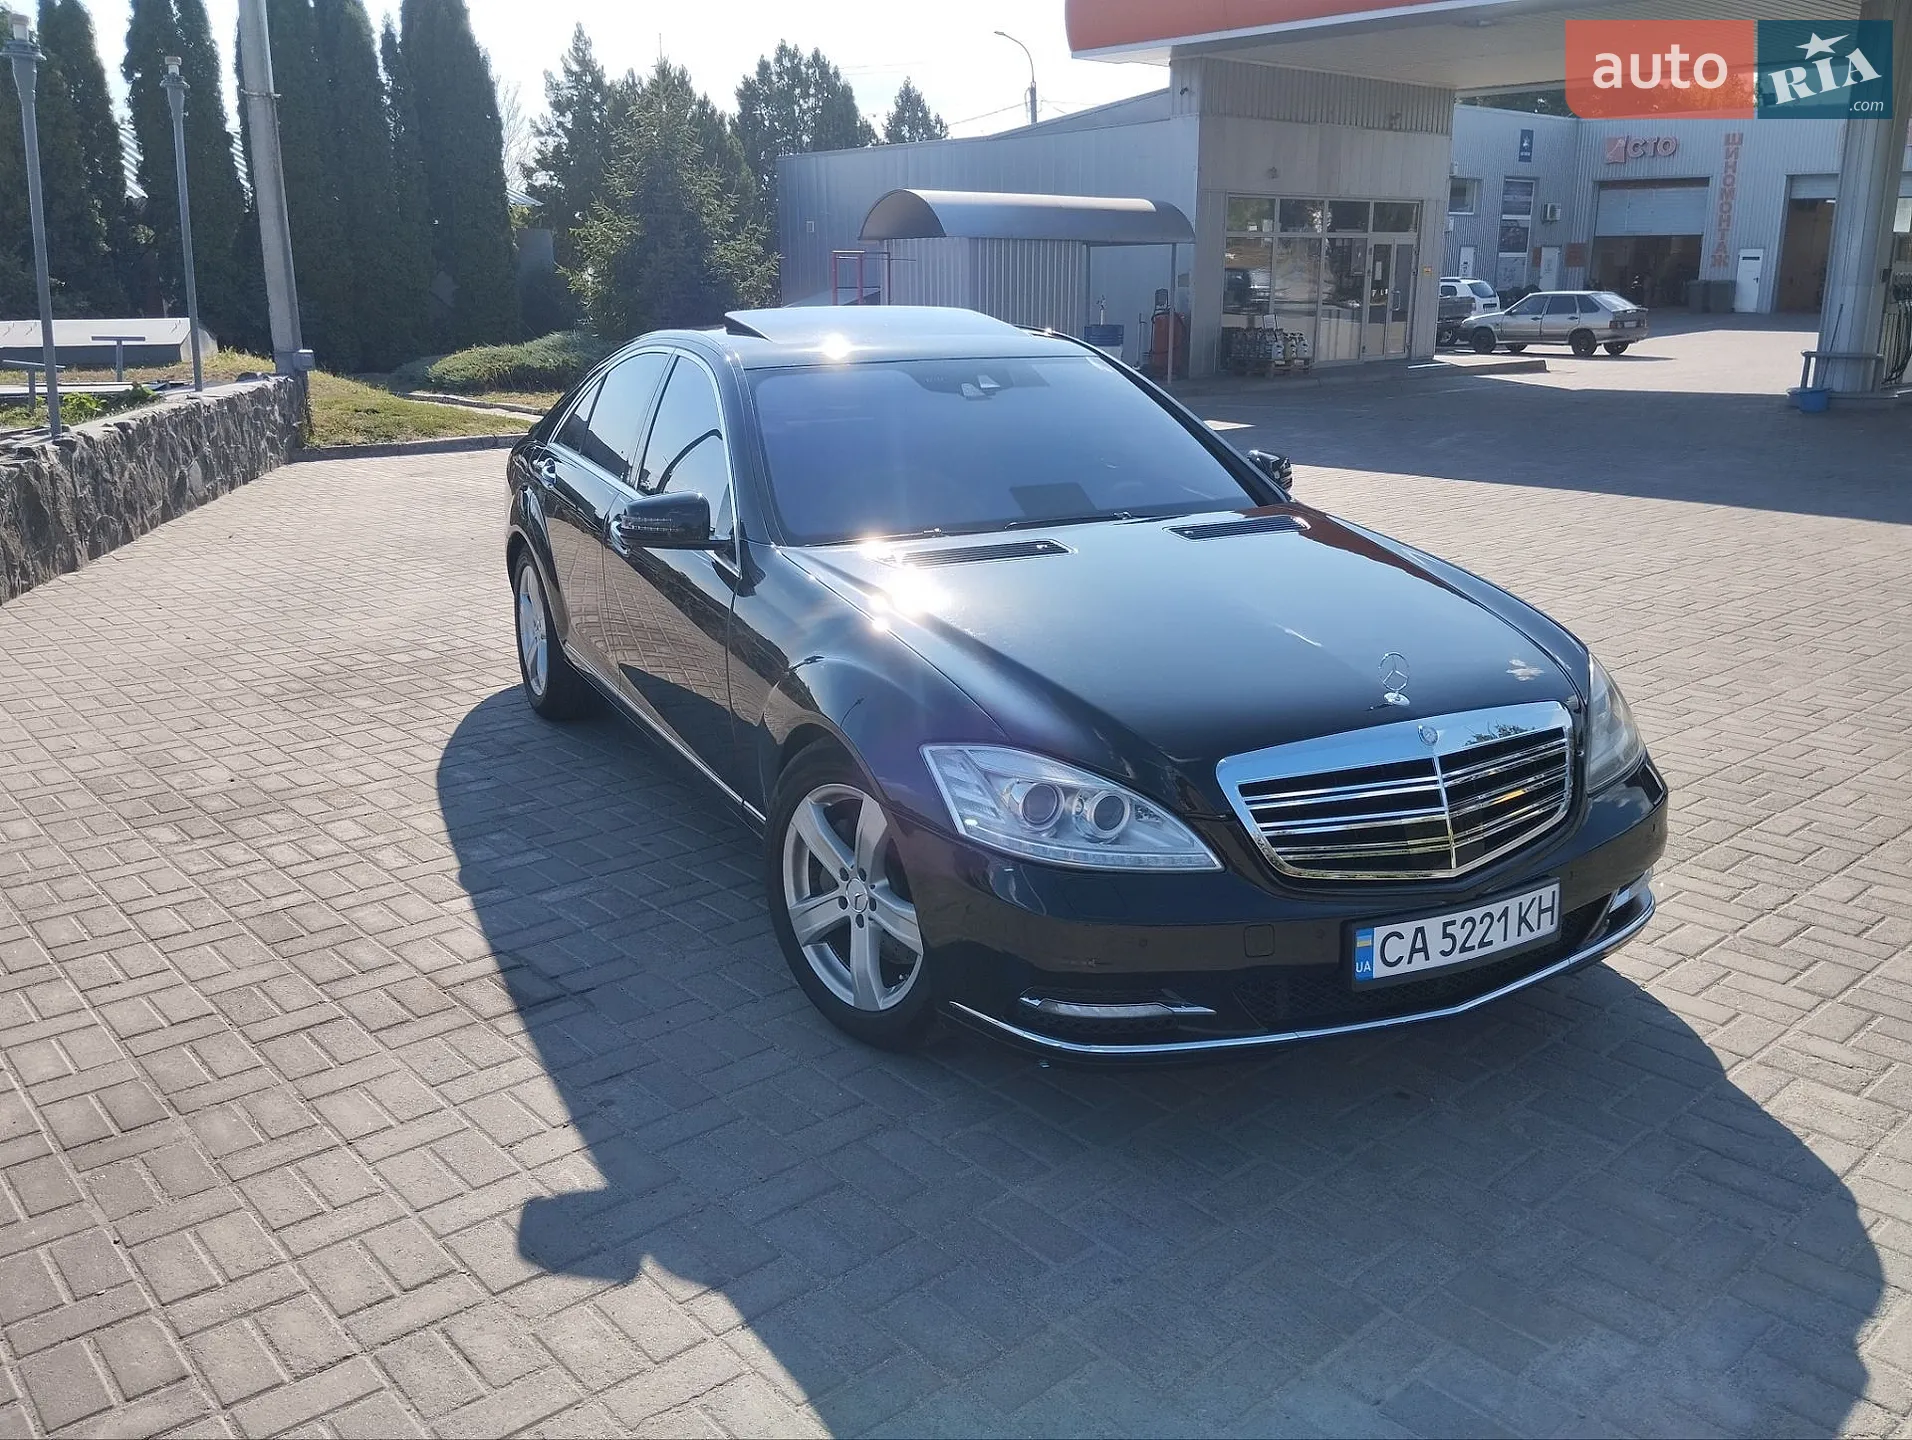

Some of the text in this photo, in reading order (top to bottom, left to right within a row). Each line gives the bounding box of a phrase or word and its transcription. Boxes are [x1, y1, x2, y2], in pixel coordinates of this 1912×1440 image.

[1627, 135, 1679, 158] СТО
[1379, 890, 1556, 968] CA 5221 KH
[1355, 961, 1371, 973] UA
